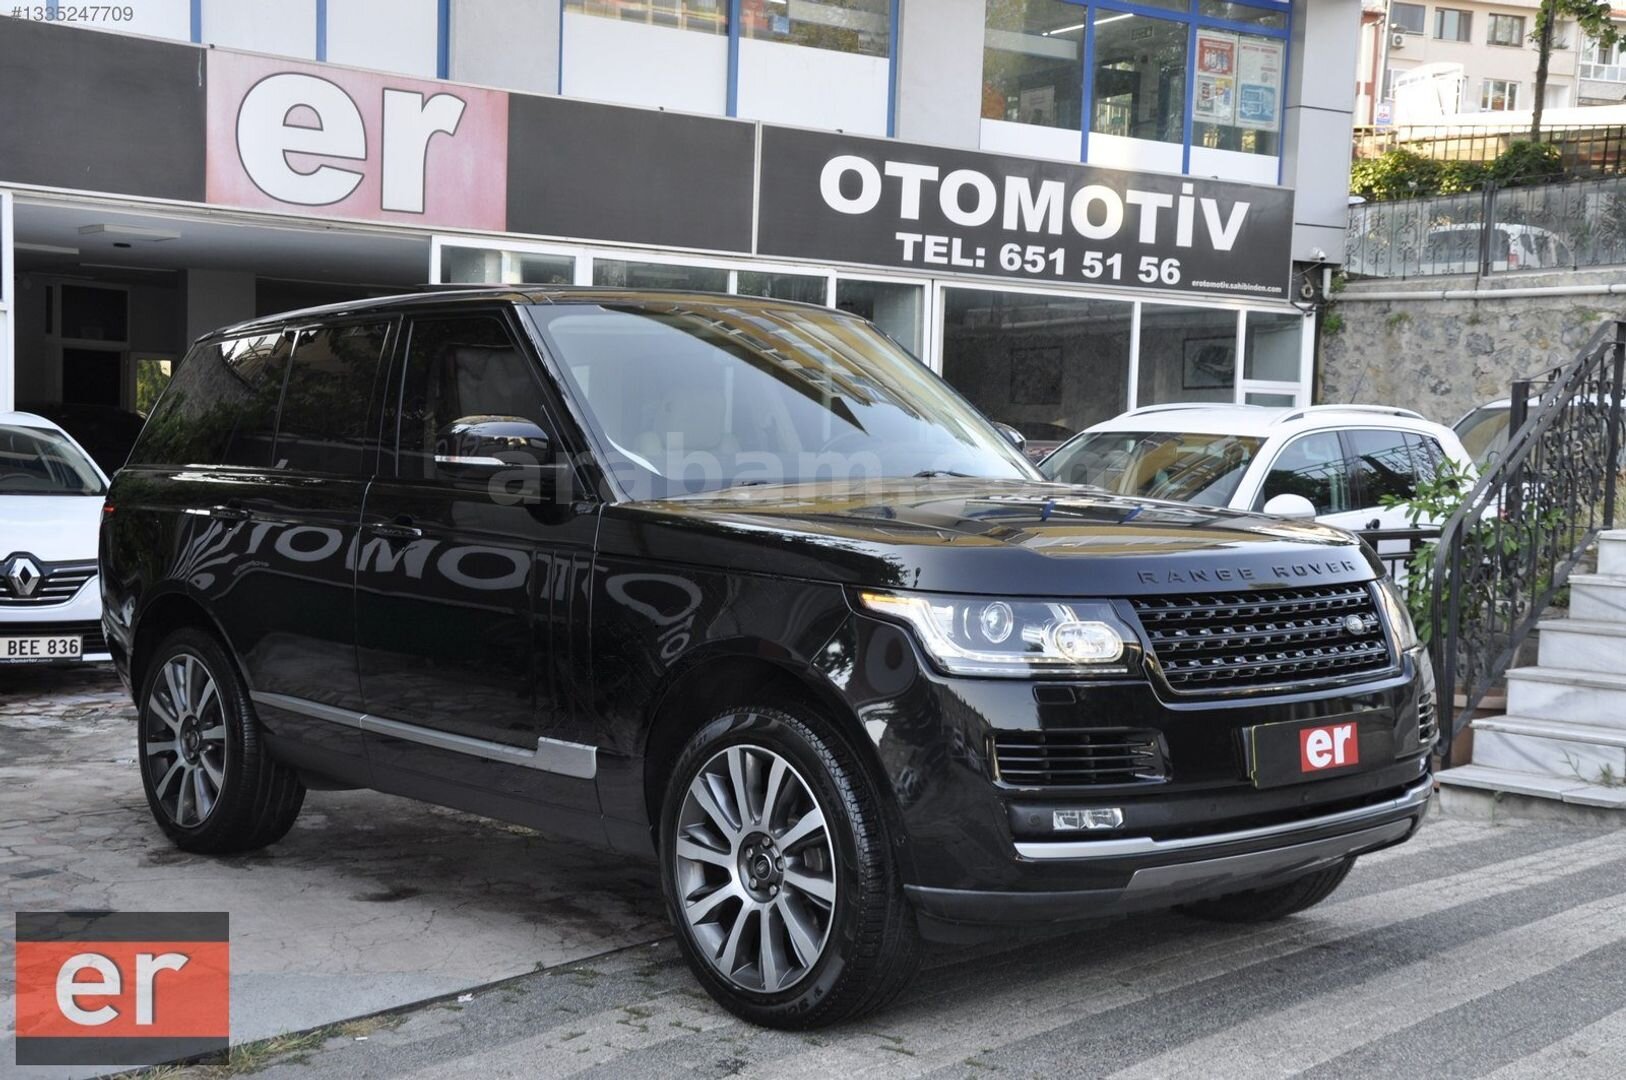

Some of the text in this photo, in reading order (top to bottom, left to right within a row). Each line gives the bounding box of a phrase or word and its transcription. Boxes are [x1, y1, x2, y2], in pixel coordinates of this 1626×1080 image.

[236, 71, 467, 214] er
[819, 154, 1250, 252] OTOMOTİV
[895, 232, 1181, 285] TEL: 651 51 56
[1191, 279, 1283, 293] erotomotiv.sahibinden.com
[1136, 560, 1357, 585] RANGE ROVER
[7, 638, 79, 656] BEE 836
[1306, 725, 1352, 769] er
